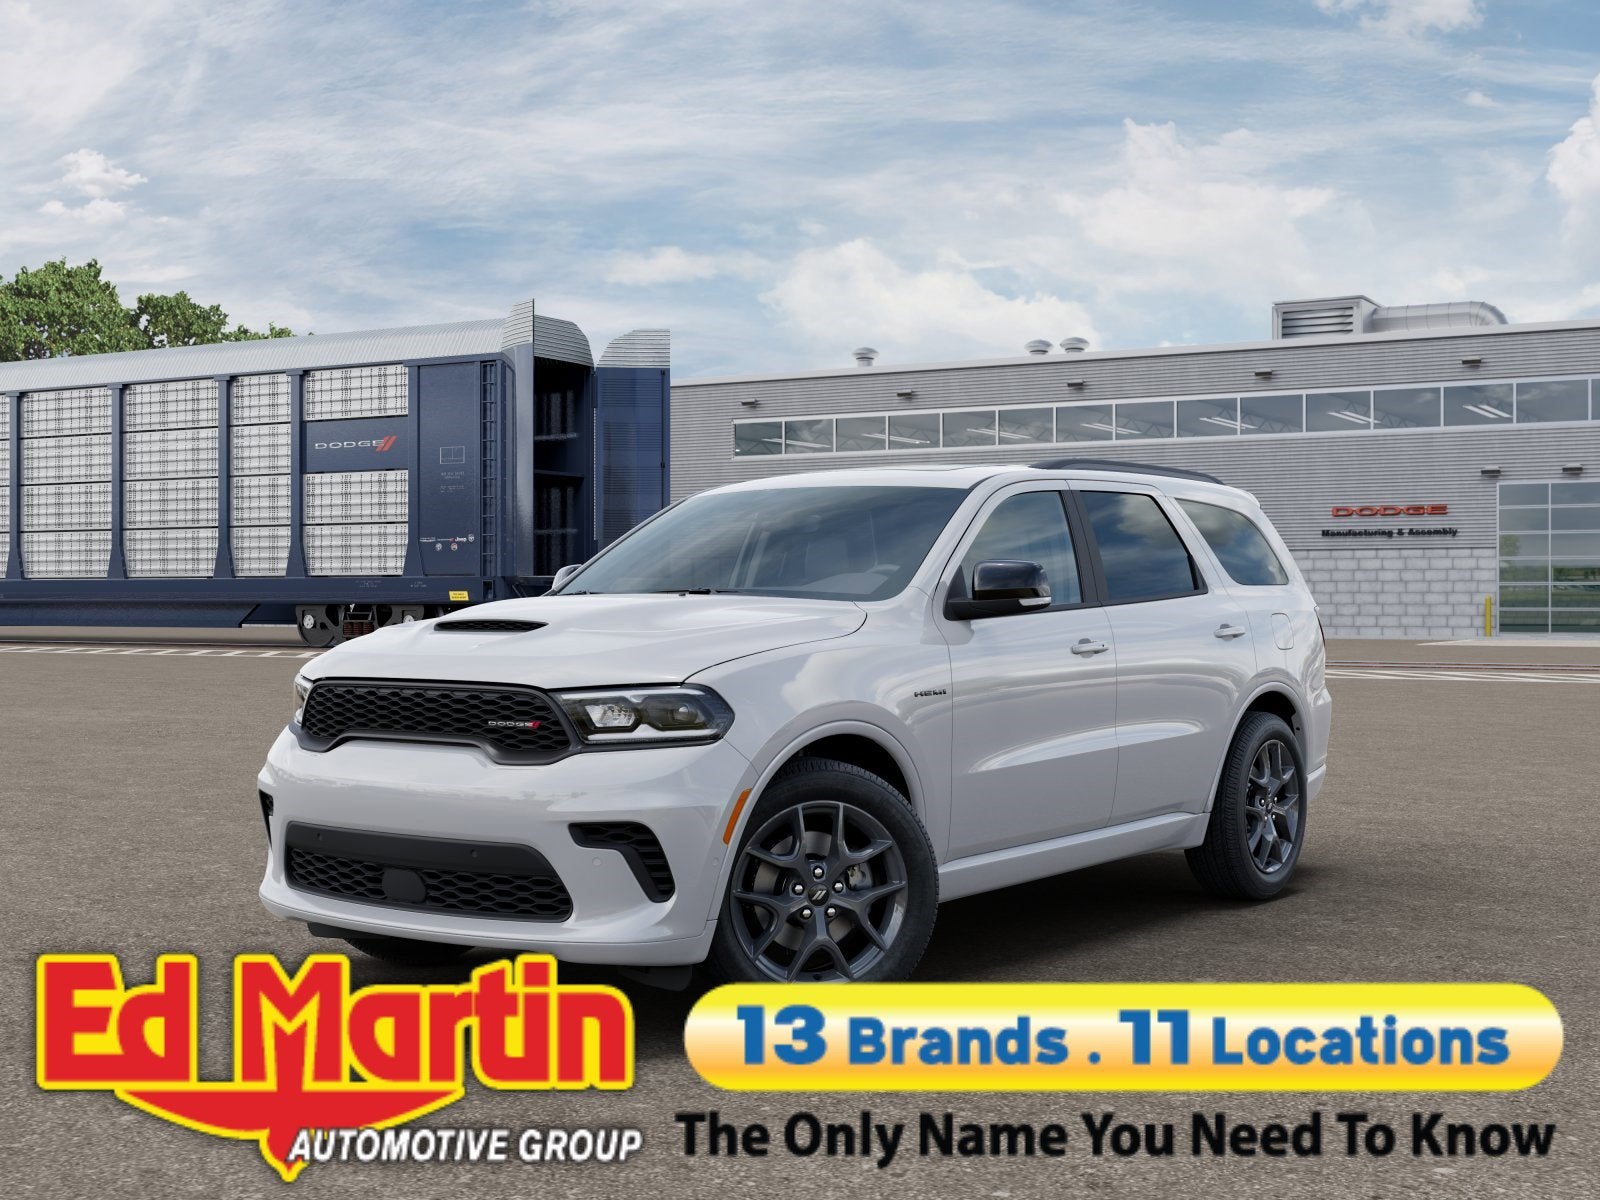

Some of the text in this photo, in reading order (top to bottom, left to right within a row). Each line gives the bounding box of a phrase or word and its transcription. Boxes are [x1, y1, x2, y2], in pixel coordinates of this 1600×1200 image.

[314, 439, 385, 450] DODGE
[1331, 504, 1449, 517] DODGE
[1321, 527, 1458, 540] Manufacturing & Assembly
